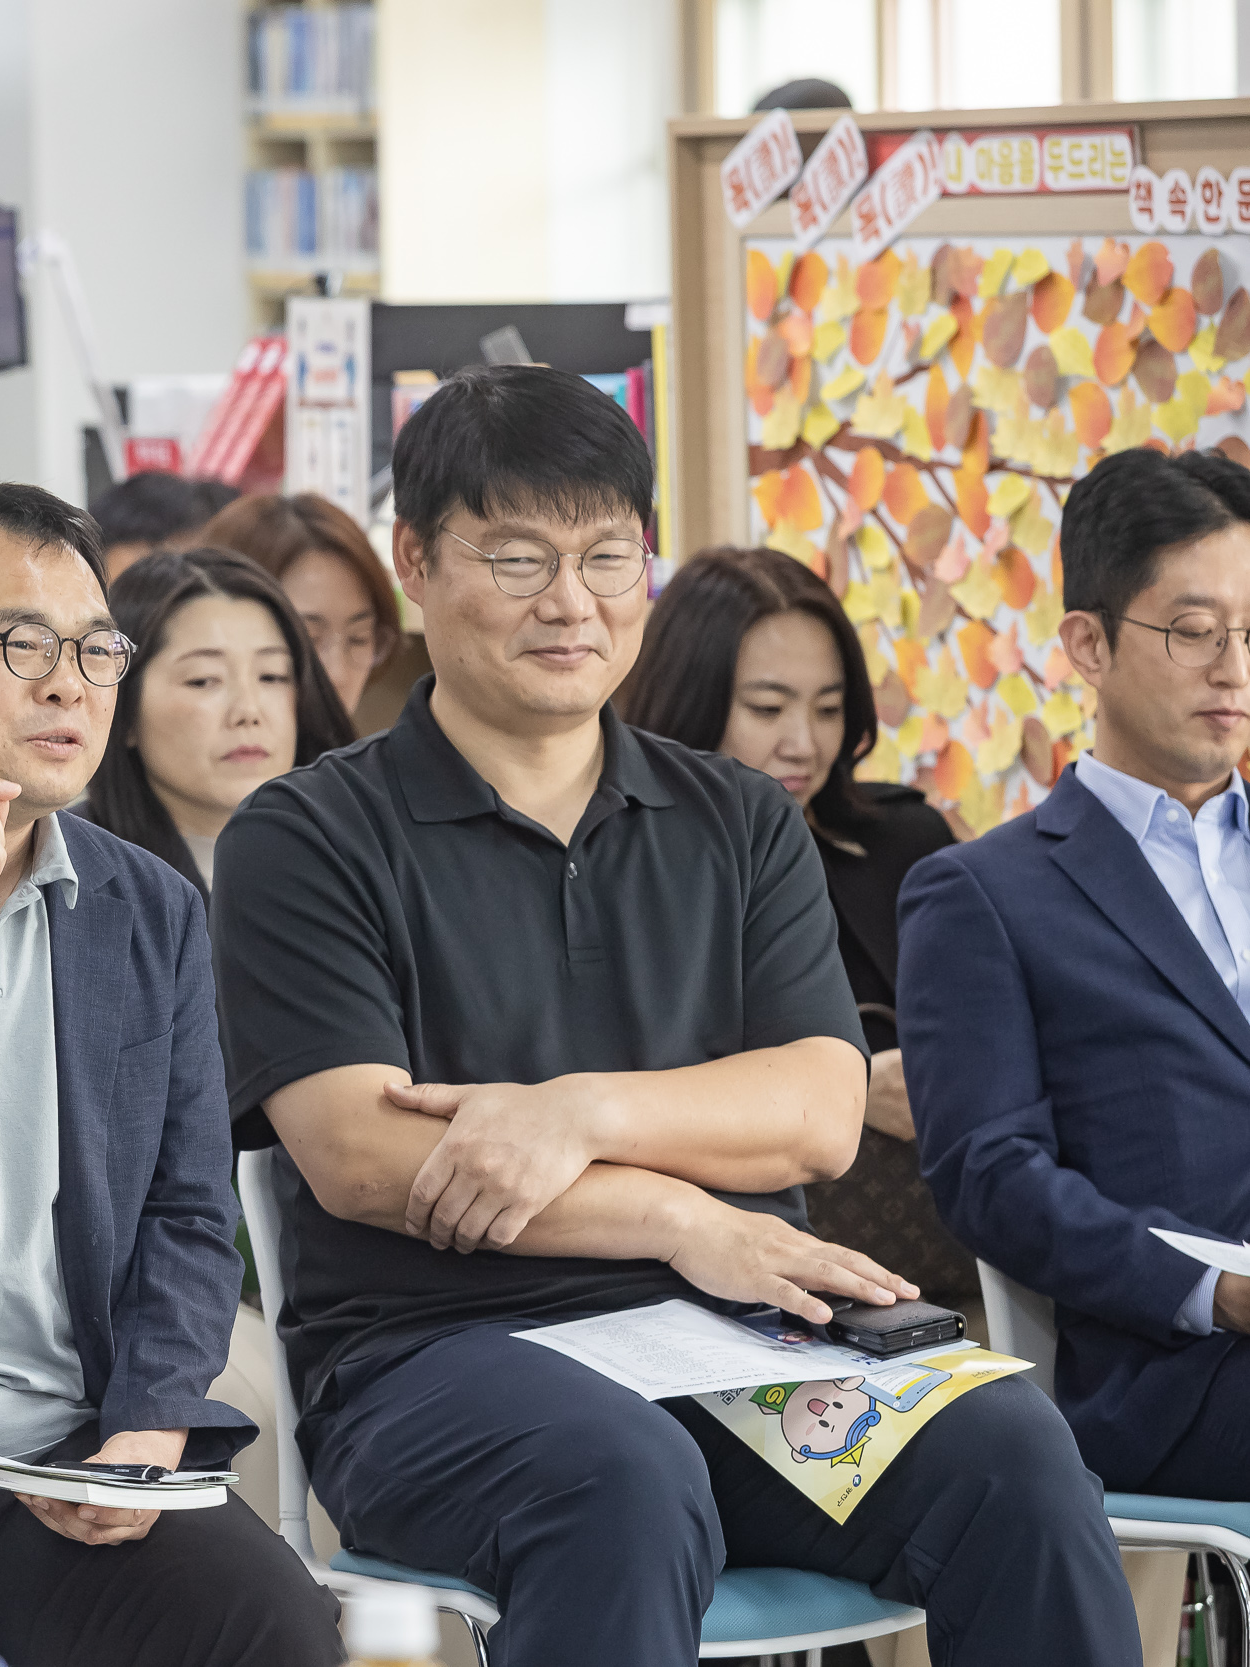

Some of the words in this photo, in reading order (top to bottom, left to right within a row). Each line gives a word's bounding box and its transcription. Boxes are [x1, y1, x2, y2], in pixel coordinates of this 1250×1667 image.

[975, 139, 1035, 186] 마음을
[1047, 138, 1127, 183] 두드리는
[1135, 180, 1153, 222] 책
[1168, 180, 1187, 221] 속
[1202, 180, 1223, 223] 한
[837, 1486, 853, 1508] 광진구
